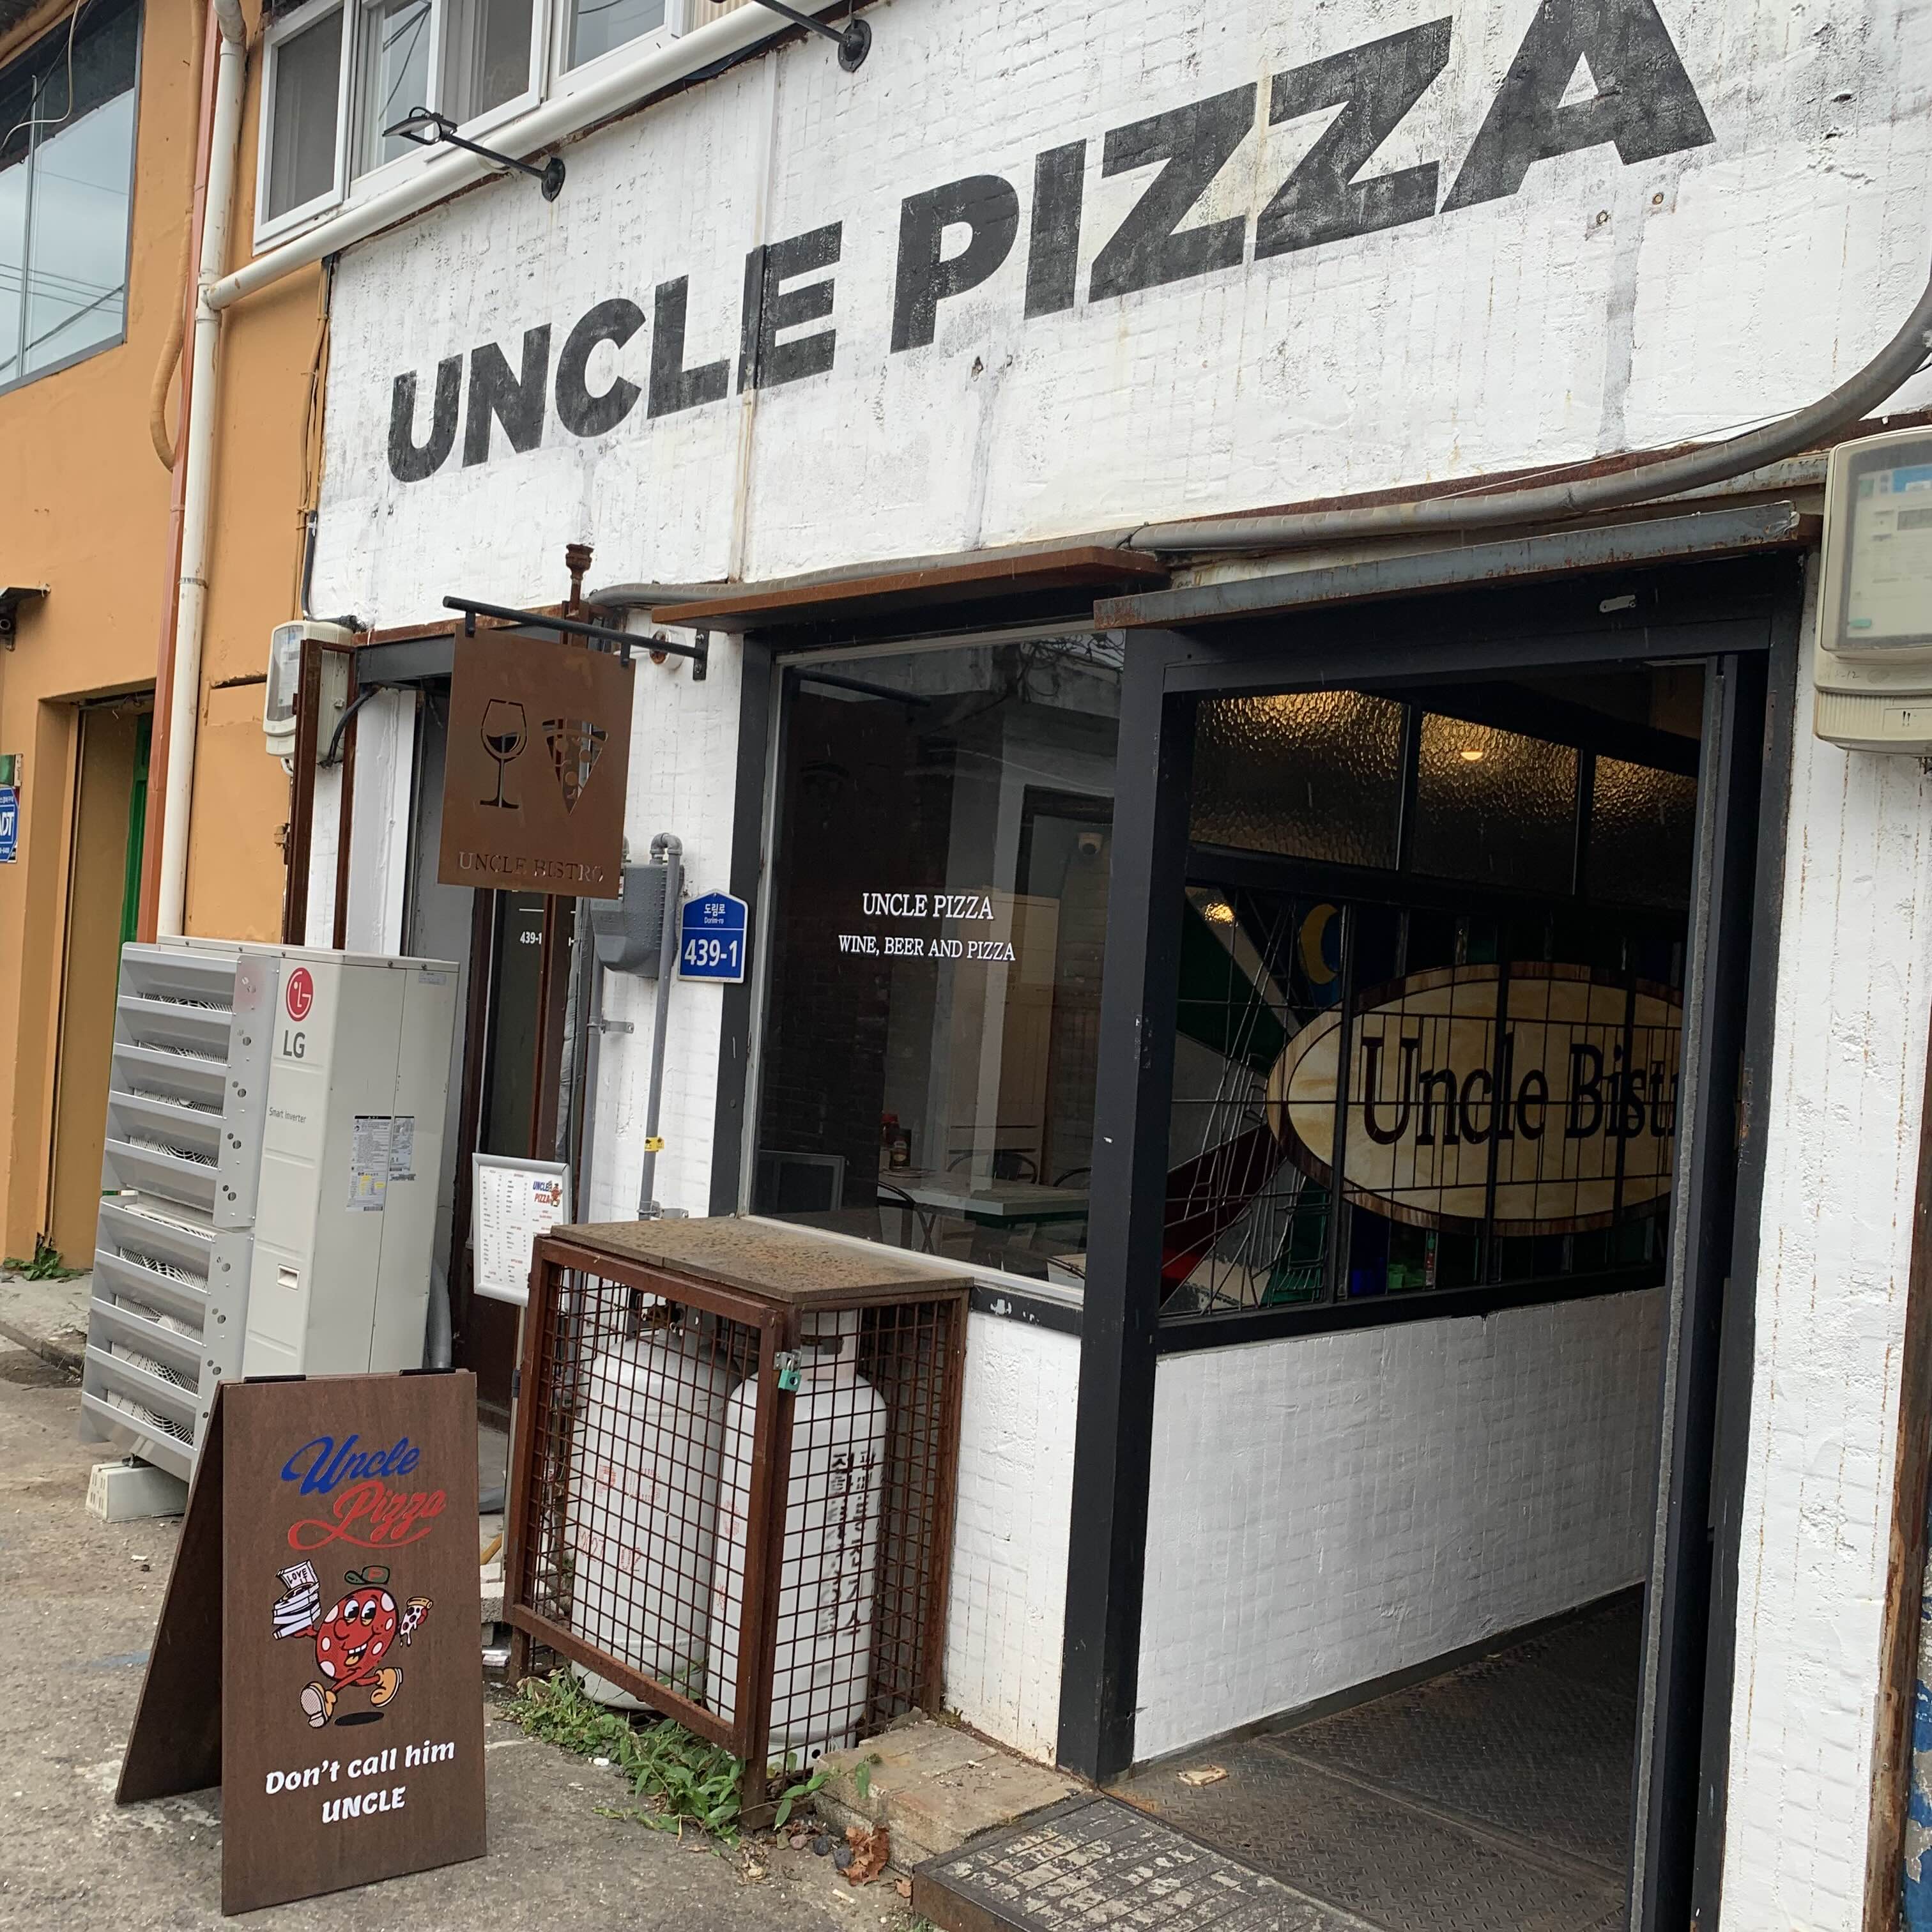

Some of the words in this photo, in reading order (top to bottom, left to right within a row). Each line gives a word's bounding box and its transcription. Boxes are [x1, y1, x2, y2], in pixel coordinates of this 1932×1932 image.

[387, 220, 843, 483] UNCLE
[891, 0, 1717, 354] PIZZA
[0, 811, 14, 836] DT
[459, 851, 526, 875] UNCLE
[534, 858, 604, 882] BISTRO
[703, 903, 726, 917] 도림로
[862, 893, 928, 917] UNCLE
[933, 895, 995, 920] PIZZA
[704, 917, 724, 925] Dorim-ro
[520, 931, 542, 945] 439-1
[838, 935, 880, 956] WINE,
[884, 937, 924, 956] BEER
[928, 939, 963, 958] AND
[967, 941, 1016, 962] PIZZA
[684, 939, 738, 968] 439-1
[282, 1029, 306, 1059] LG
[1361, 1031, 1549, 1145] Uncle
[269, 1107, 284, 1119] Smart
[532, 1180, 549, 1192] UNCLE
[534, 1193, 551, 1204] PIZZA
[280, 1434, 420, 1496] Uncle
[288, 1479, 446, 1551] Pizza
[286, 1568, 307, 1584] LOVE
[300, 1575, 308, 1584] IT
[265, 1758, 341, 1795] Don't
[347, 1747, 397, 1779] call
[404, 1739, 456, 1768] him
[321, 1786, 407, 1825] UNCLE
